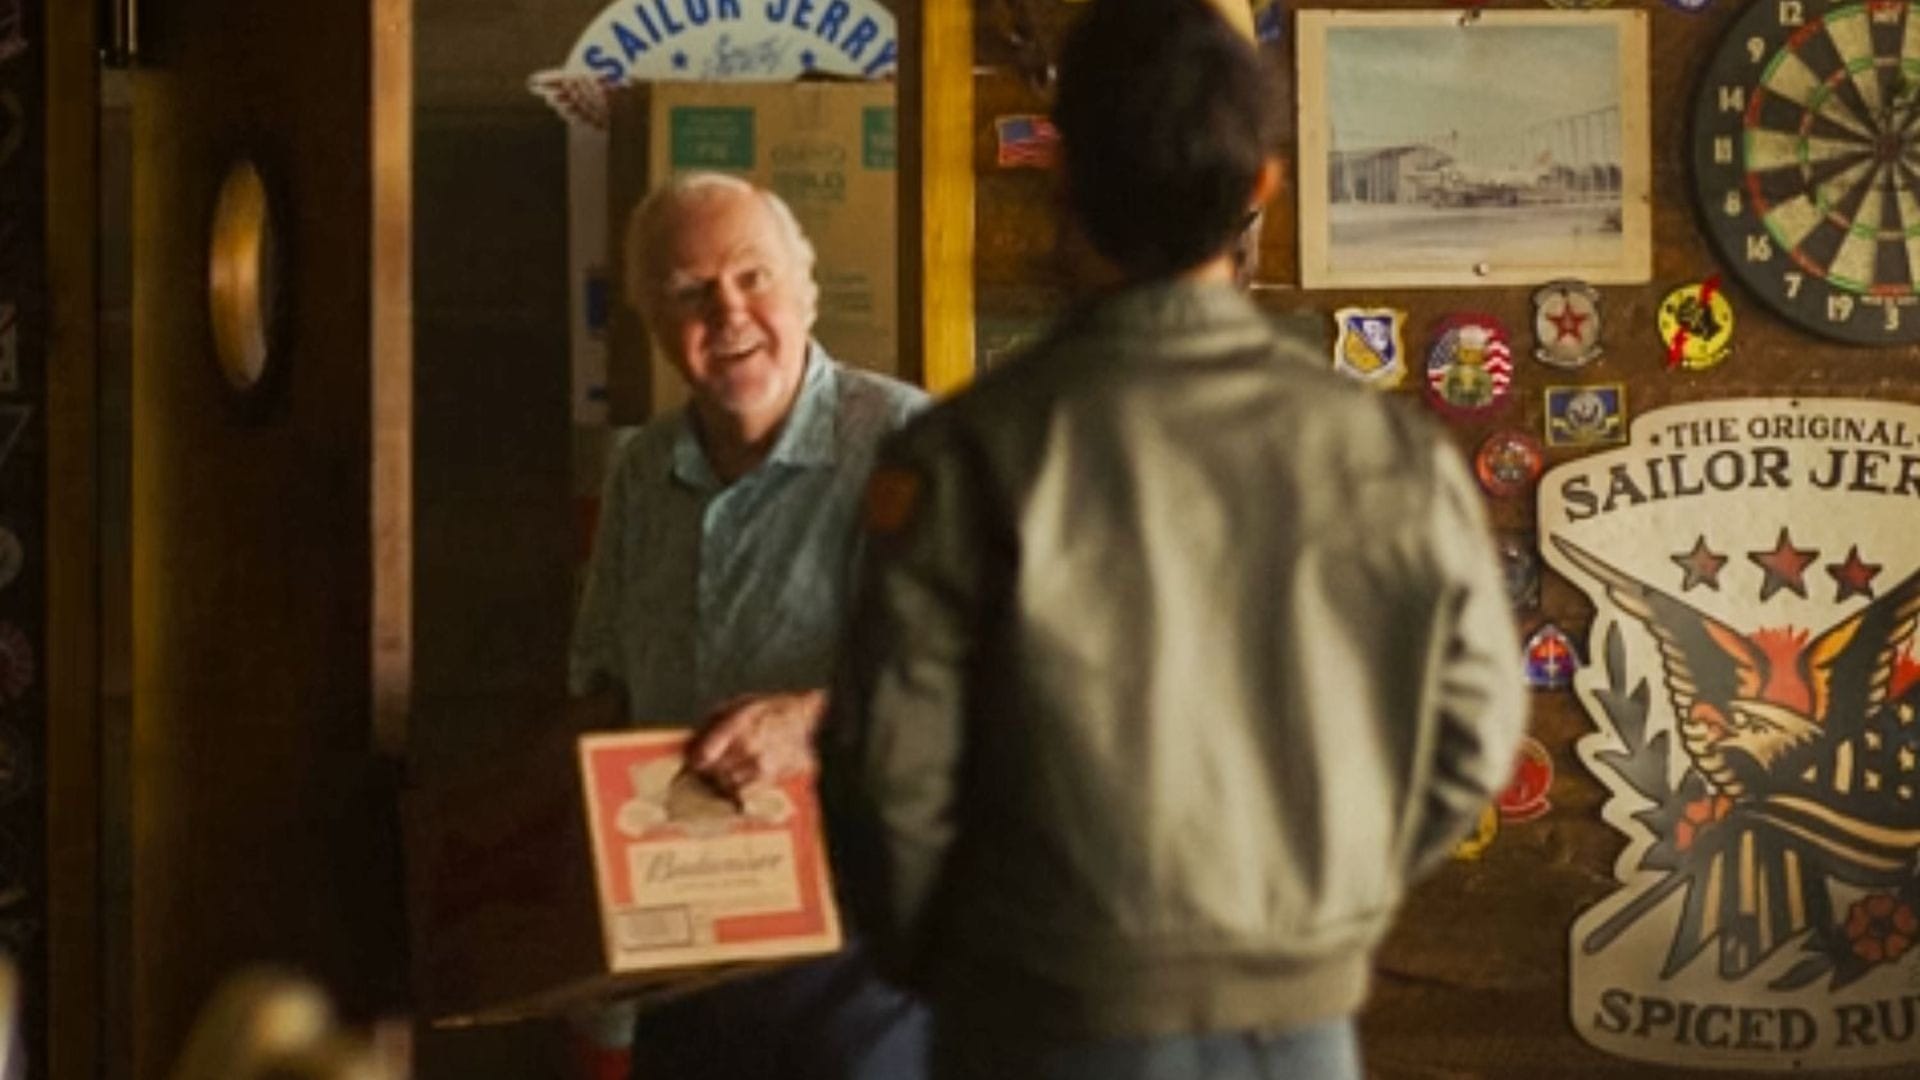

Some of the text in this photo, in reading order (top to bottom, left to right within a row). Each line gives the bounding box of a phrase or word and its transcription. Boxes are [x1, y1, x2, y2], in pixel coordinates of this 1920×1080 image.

[1667, 415, 1914, 449] THE ORIGINAL
[1561, 447, 1791, 523] SAILOR
[1594, 988, 1920, 1050] SPICED RU
